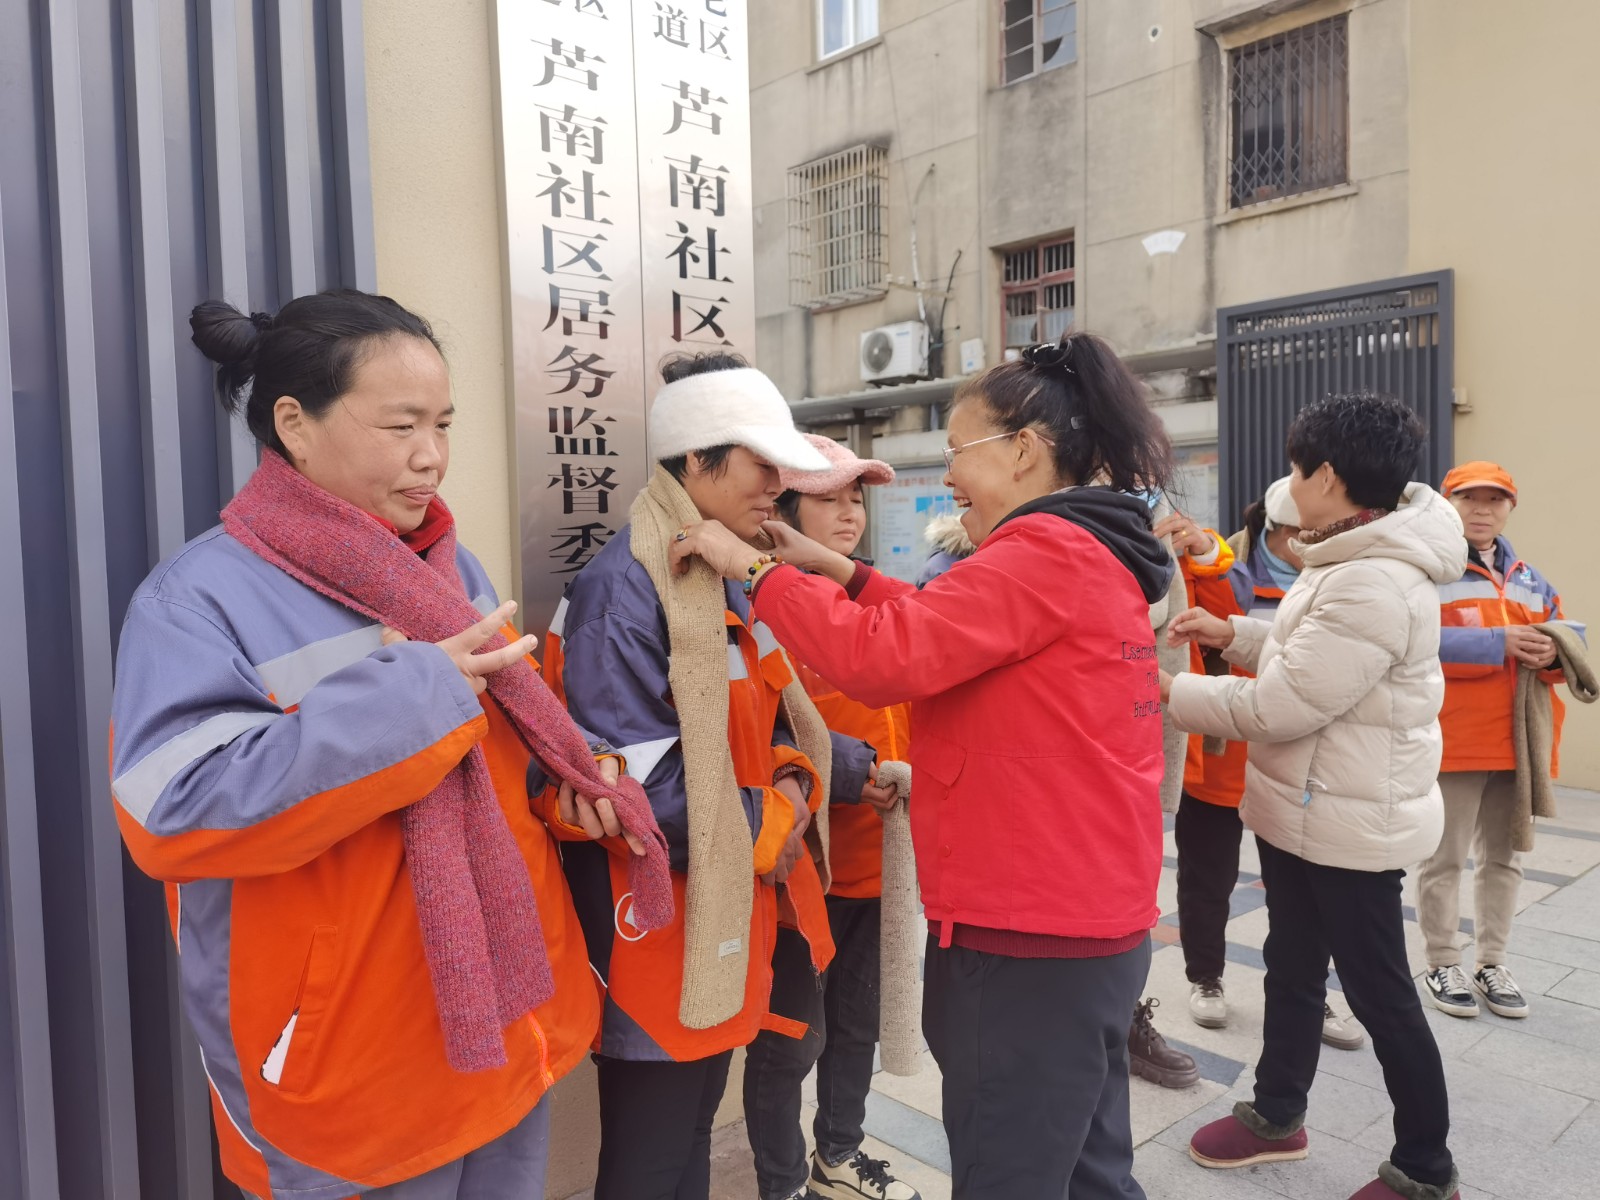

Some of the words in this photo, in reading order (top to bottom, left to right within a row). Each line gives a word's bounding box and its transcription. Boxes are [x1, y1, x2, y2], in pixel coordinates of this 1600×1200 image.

[530, 37, 619, 589] 芦南社区居务监督委
[661, 80, 734, 347] 芦南社区
